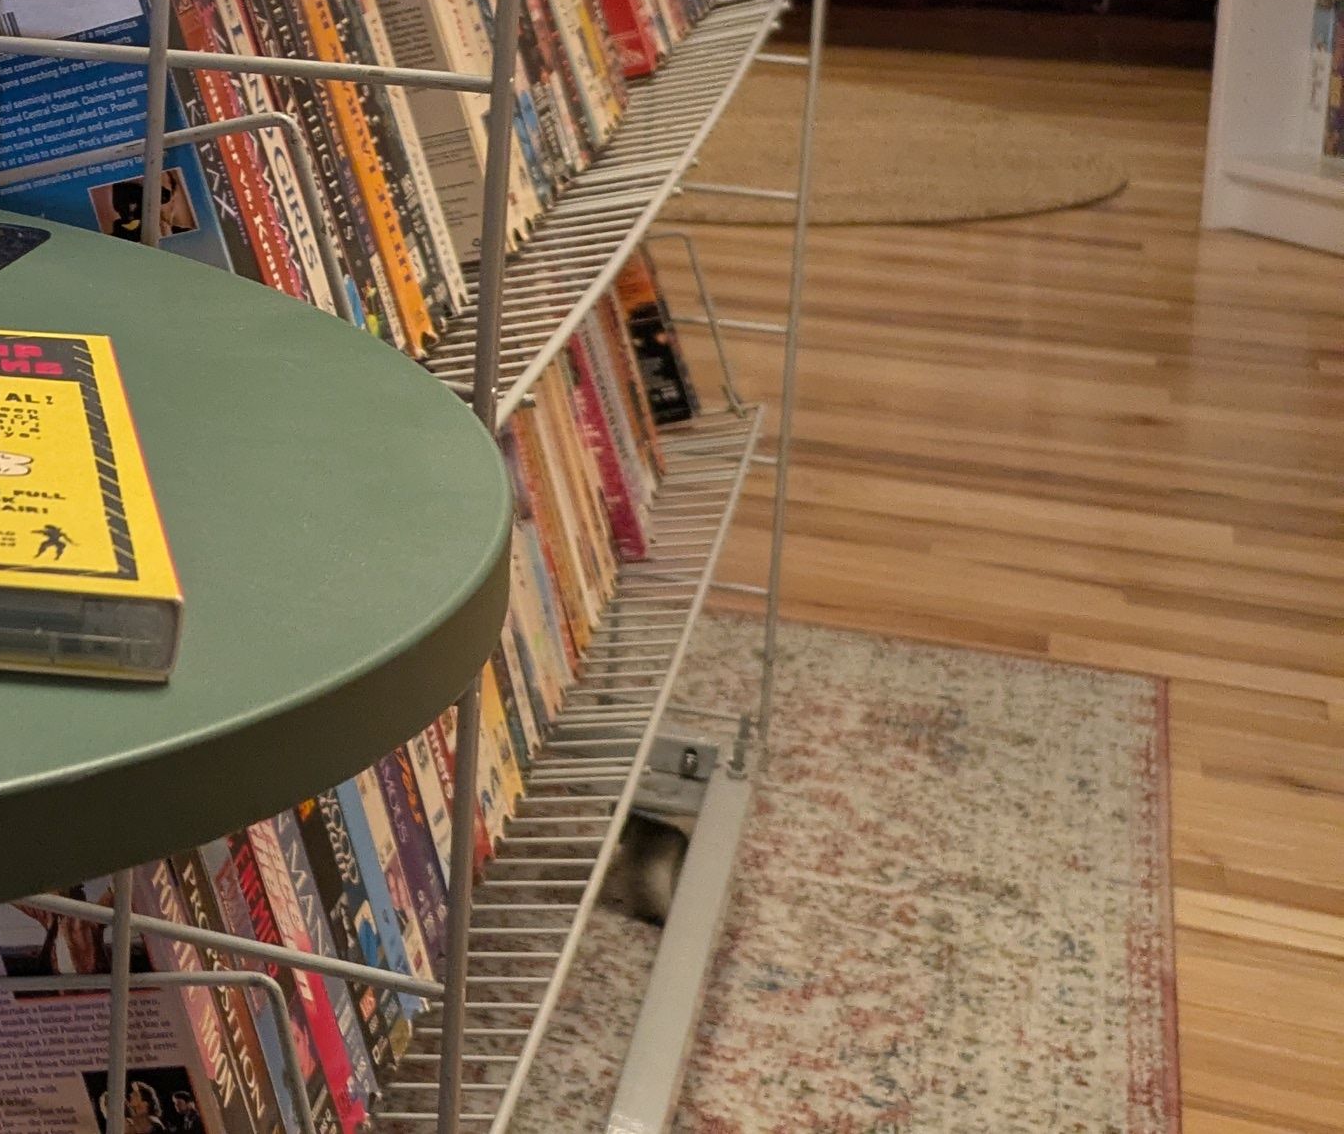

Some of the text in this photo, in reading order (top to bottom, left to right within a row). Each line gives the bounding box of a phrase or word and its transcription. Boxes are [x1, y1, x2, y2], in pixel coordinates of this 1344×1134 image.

[267, 145, 324, 270] GIRLS
[298, 99, 360, 242] HEIGHTS
[13, 489, 67, 501] FULL
